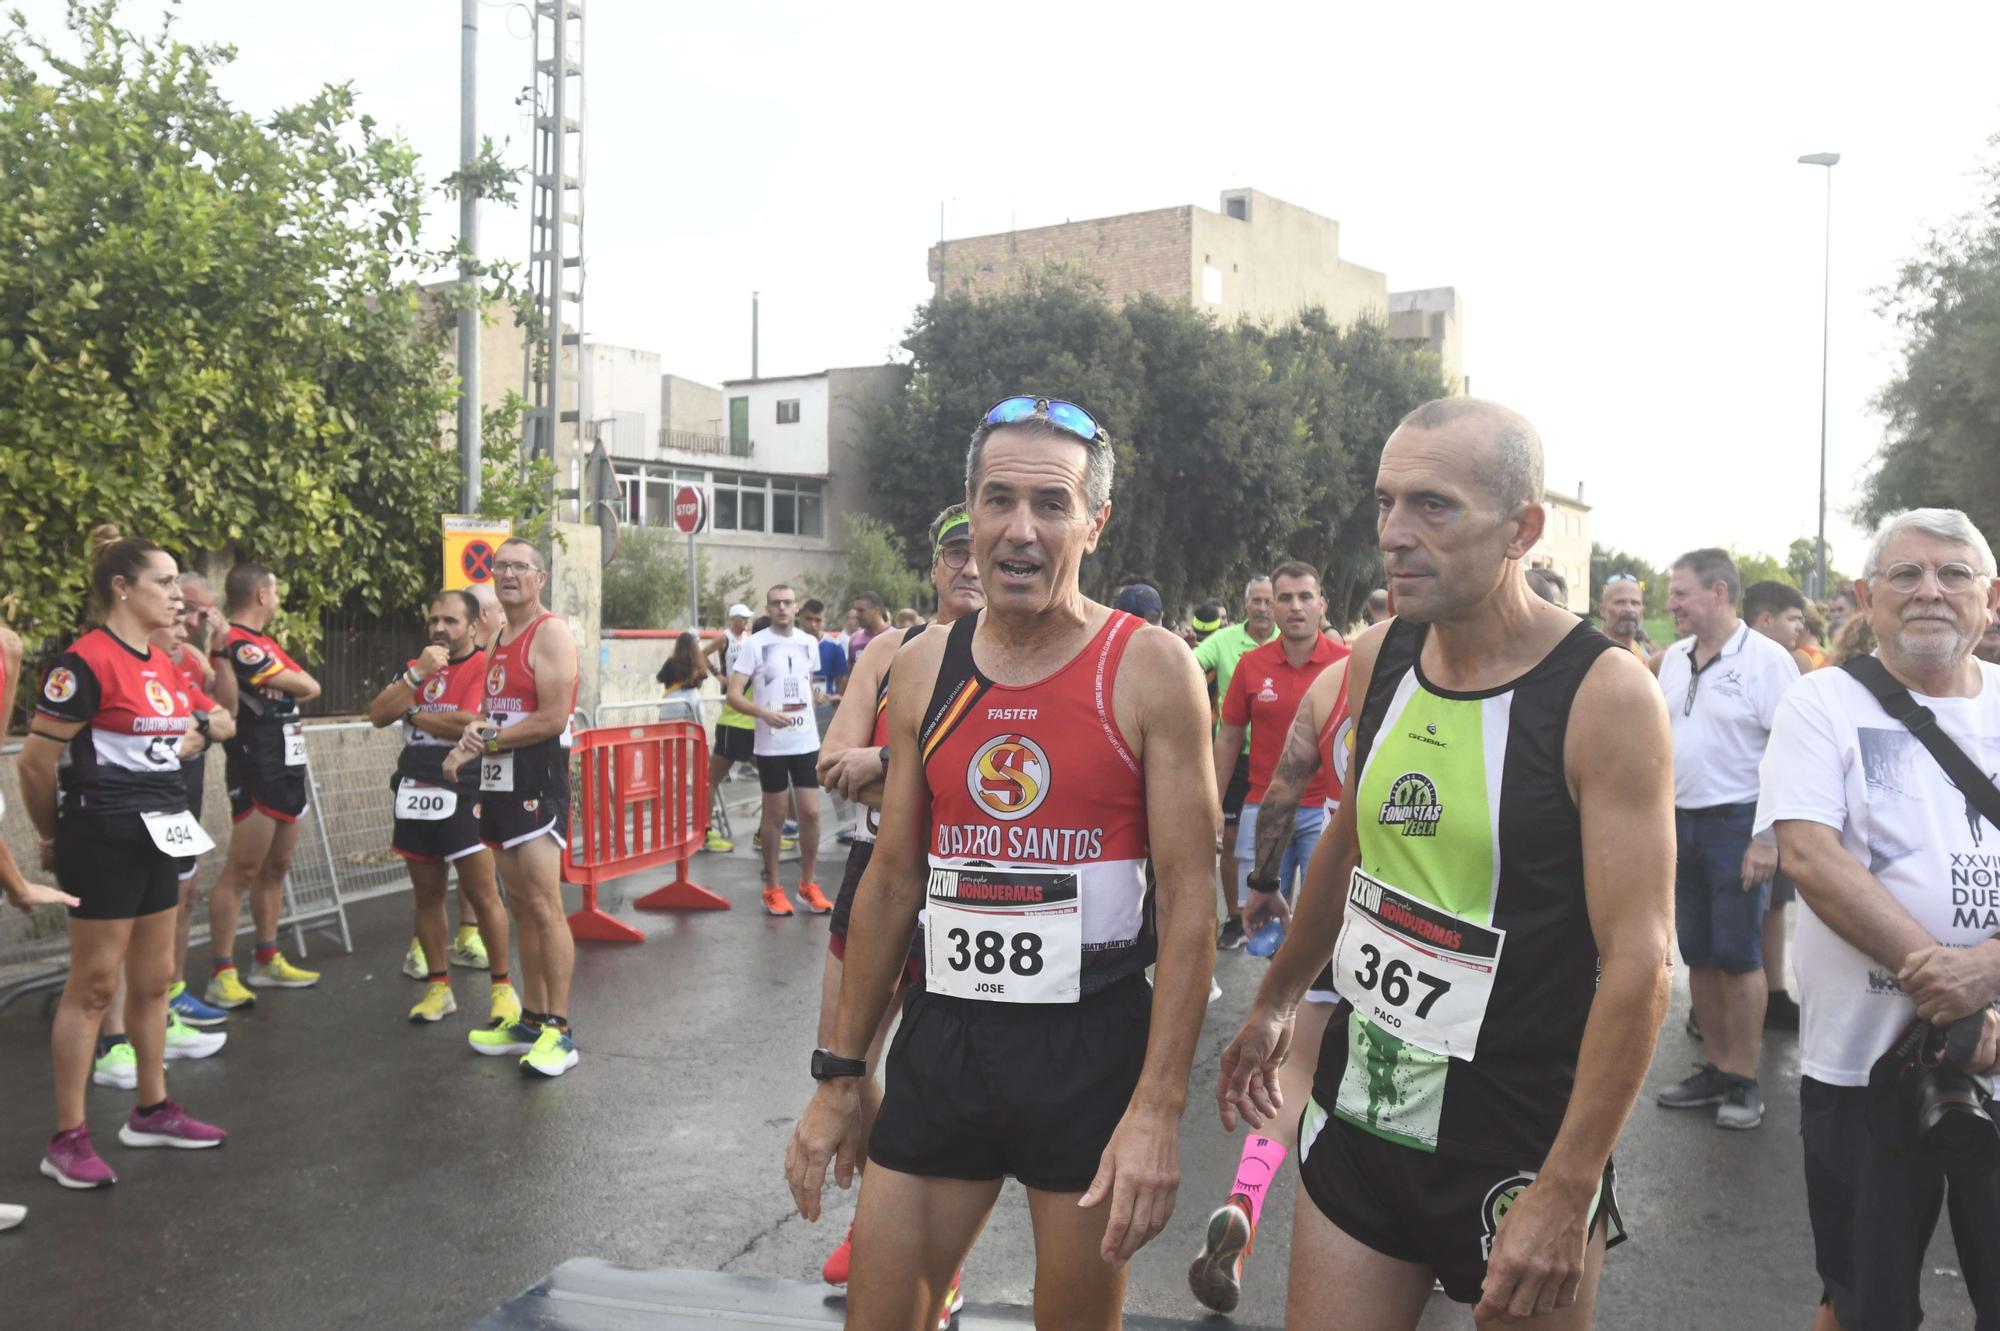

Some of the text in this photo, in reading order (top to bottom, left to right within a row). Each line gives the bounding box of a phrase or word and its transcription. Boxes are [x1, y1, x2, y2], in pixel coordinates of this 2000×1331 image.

[677, 503, 696, 516] STOP
[493, 697, 522, 711] SANTOS
[987, 708, 1038, 720] FASTER
[133, 716, 168, 732] CUATRO
[1408, 732, 1448, 749] GOBIK
[407, 796, 444, 811] 200
[1379, 803, 1442, 824] FONDISTAS
[166, 825, 193, 845] 494
[1403, 819, 1436, 836] YECLA
[1007, 826, 1103, 862] SANTOS
[930, 869, 959, 898] XXVIII
[958, 883, 1043, 901] NONDUERMAS
[1352, 874, 1383, 914] XXVIII
[1379, 901, 1462, 950] NONDUERMAS
[948, 928, 1044, 976] 388
[974, 983, 1005, 994] JOSE
[1355, 943, 1452, 1020] 367
[1374, 1006, 1402, 1029] PACO
